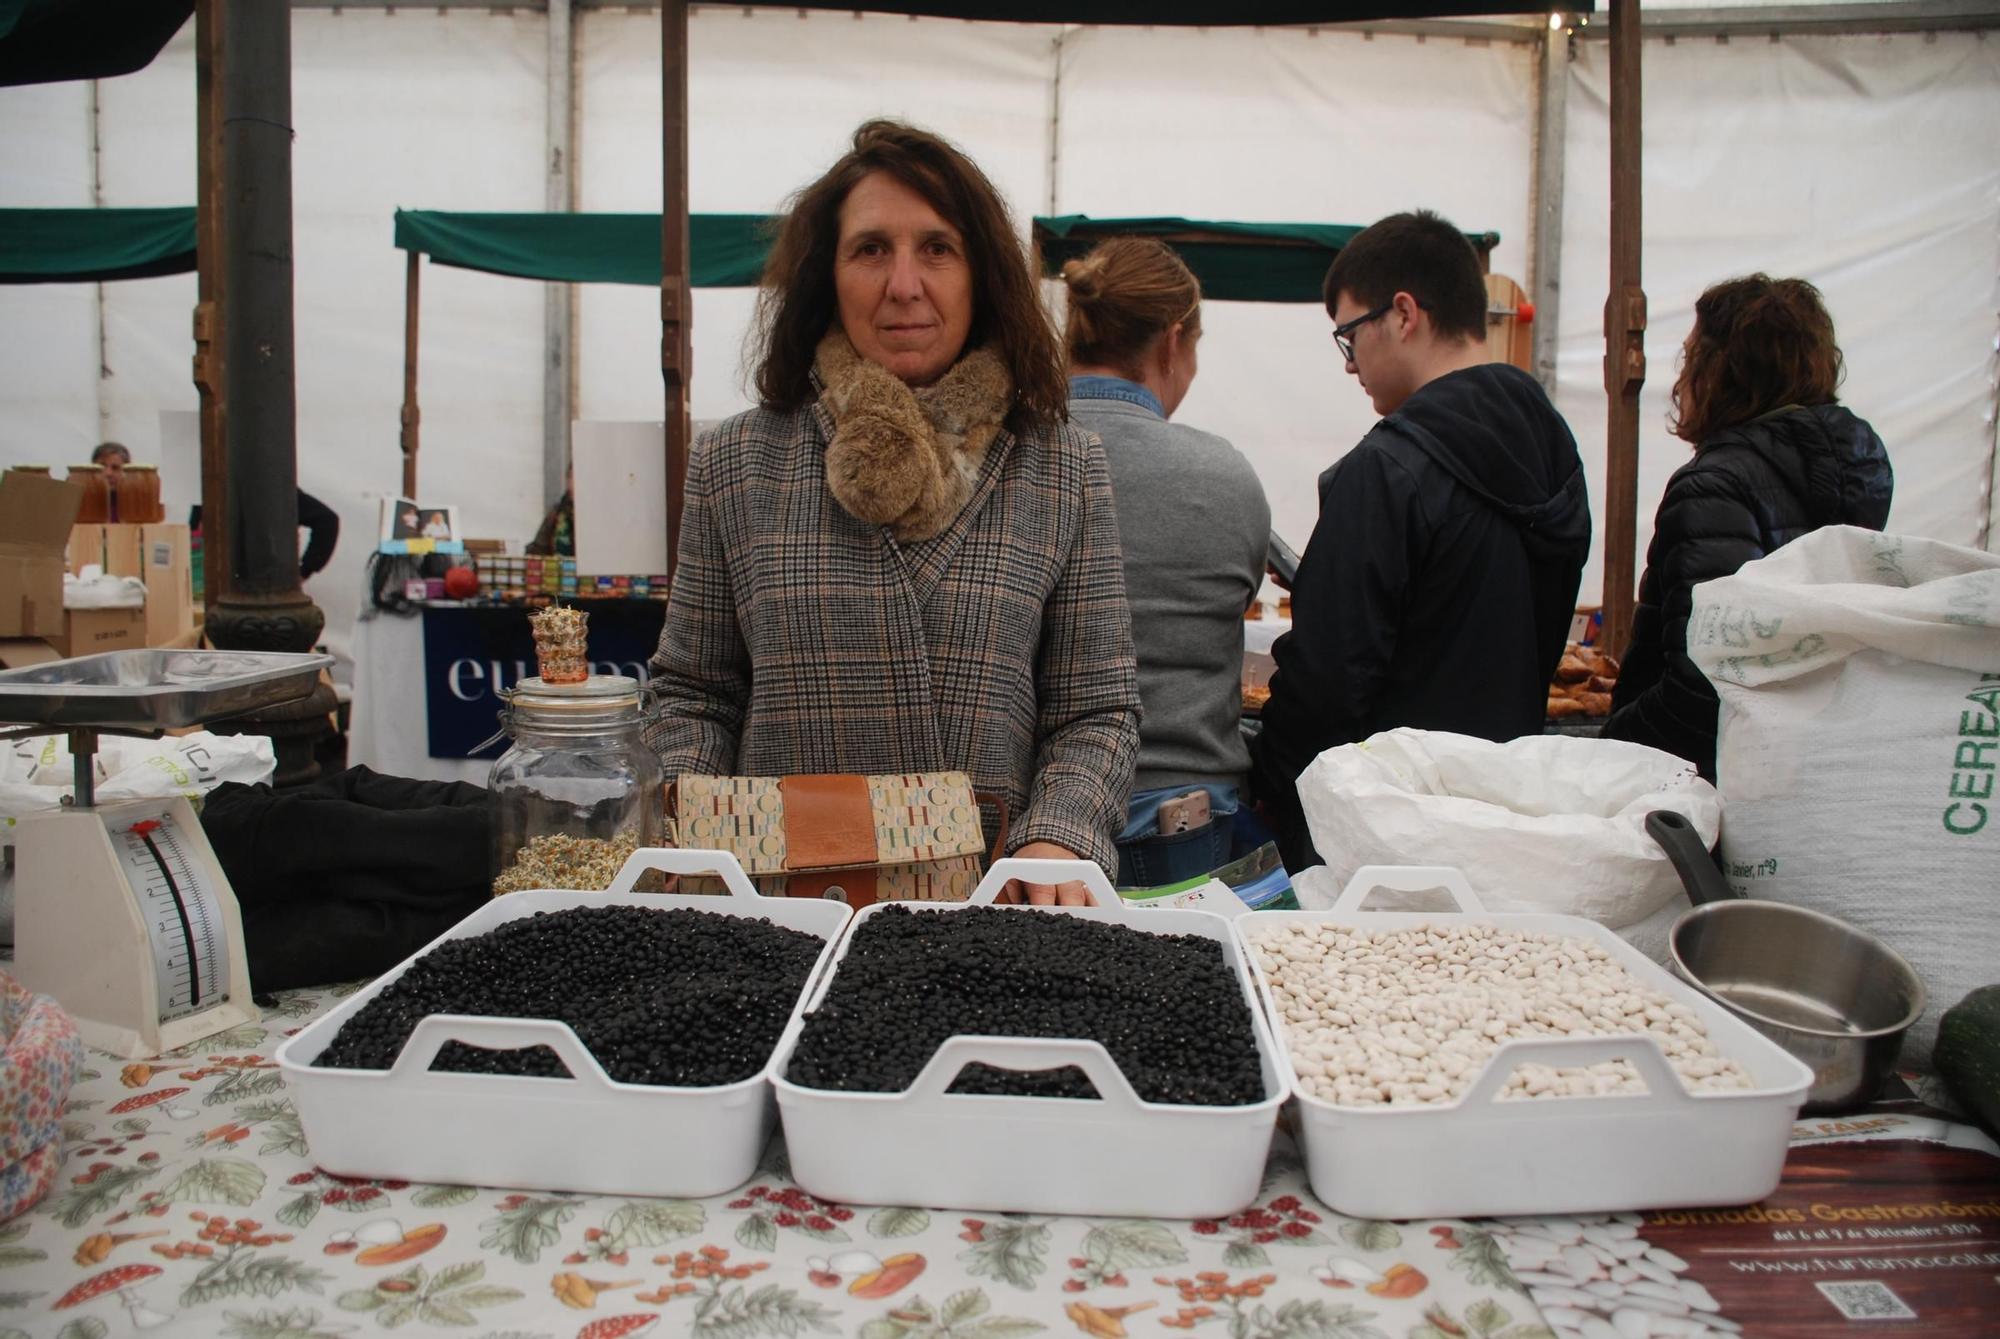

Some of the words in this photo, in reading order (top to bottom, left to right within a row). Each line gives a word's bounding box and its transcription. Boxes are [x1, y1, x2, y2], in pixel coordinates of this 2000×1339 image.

[1943, 672, 2000, 835] CEREA
[1652, 1203, 1806, 1226] Jornadas
[1773, 1229, 1796, 1241] del
